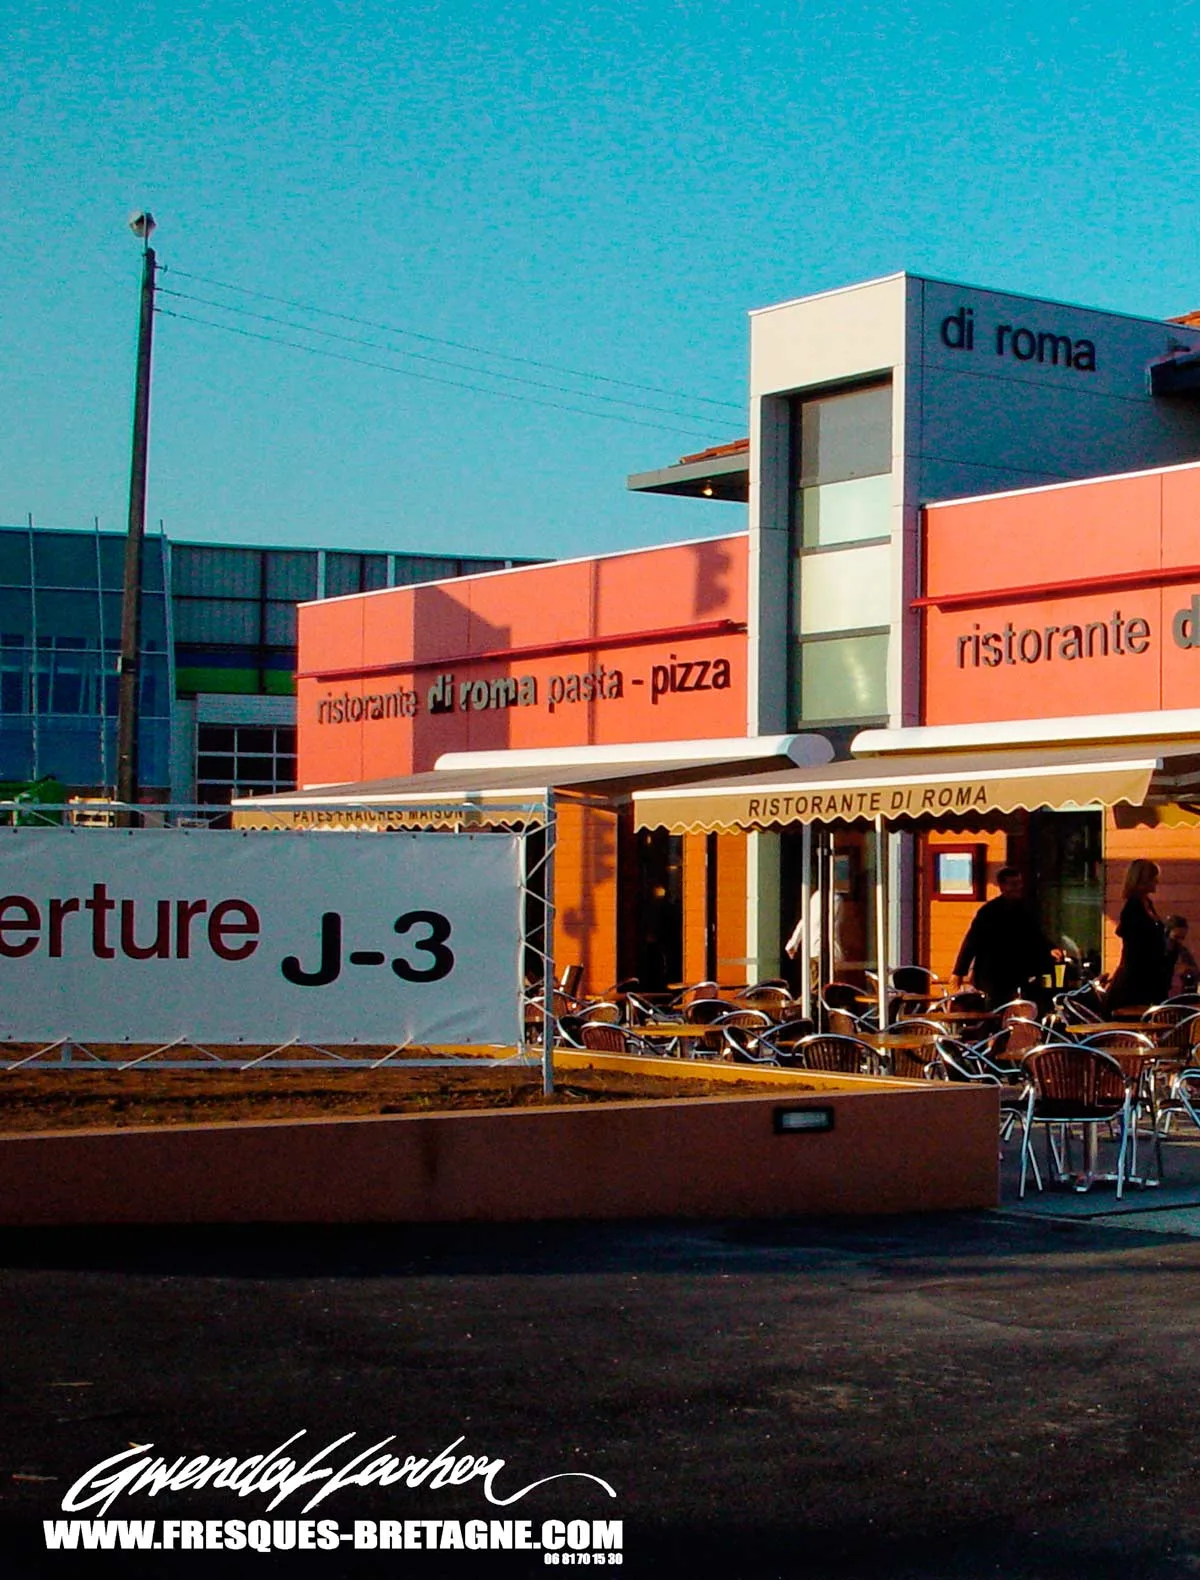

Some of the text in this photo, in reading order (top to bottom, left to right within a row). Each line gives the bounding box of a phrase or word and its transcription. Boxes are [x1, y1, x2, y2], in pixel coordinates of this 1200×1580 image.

[940, 308, 1097, 372] di roma
[957, 610, 1150, 669] ristorante
[316, 686, 417, 725] ristorante
[427, 674, 454, 714] di
[459, 675, 538, 711] roma
[548, 664, 623, 713] pasta
[651, 654, 731, 704] pizza
[408, 808, 463, 821] MAISON
[748, 785, 988, 818] RISTORANTE DI ROMA
[281, 910, 455, 987] J-3
